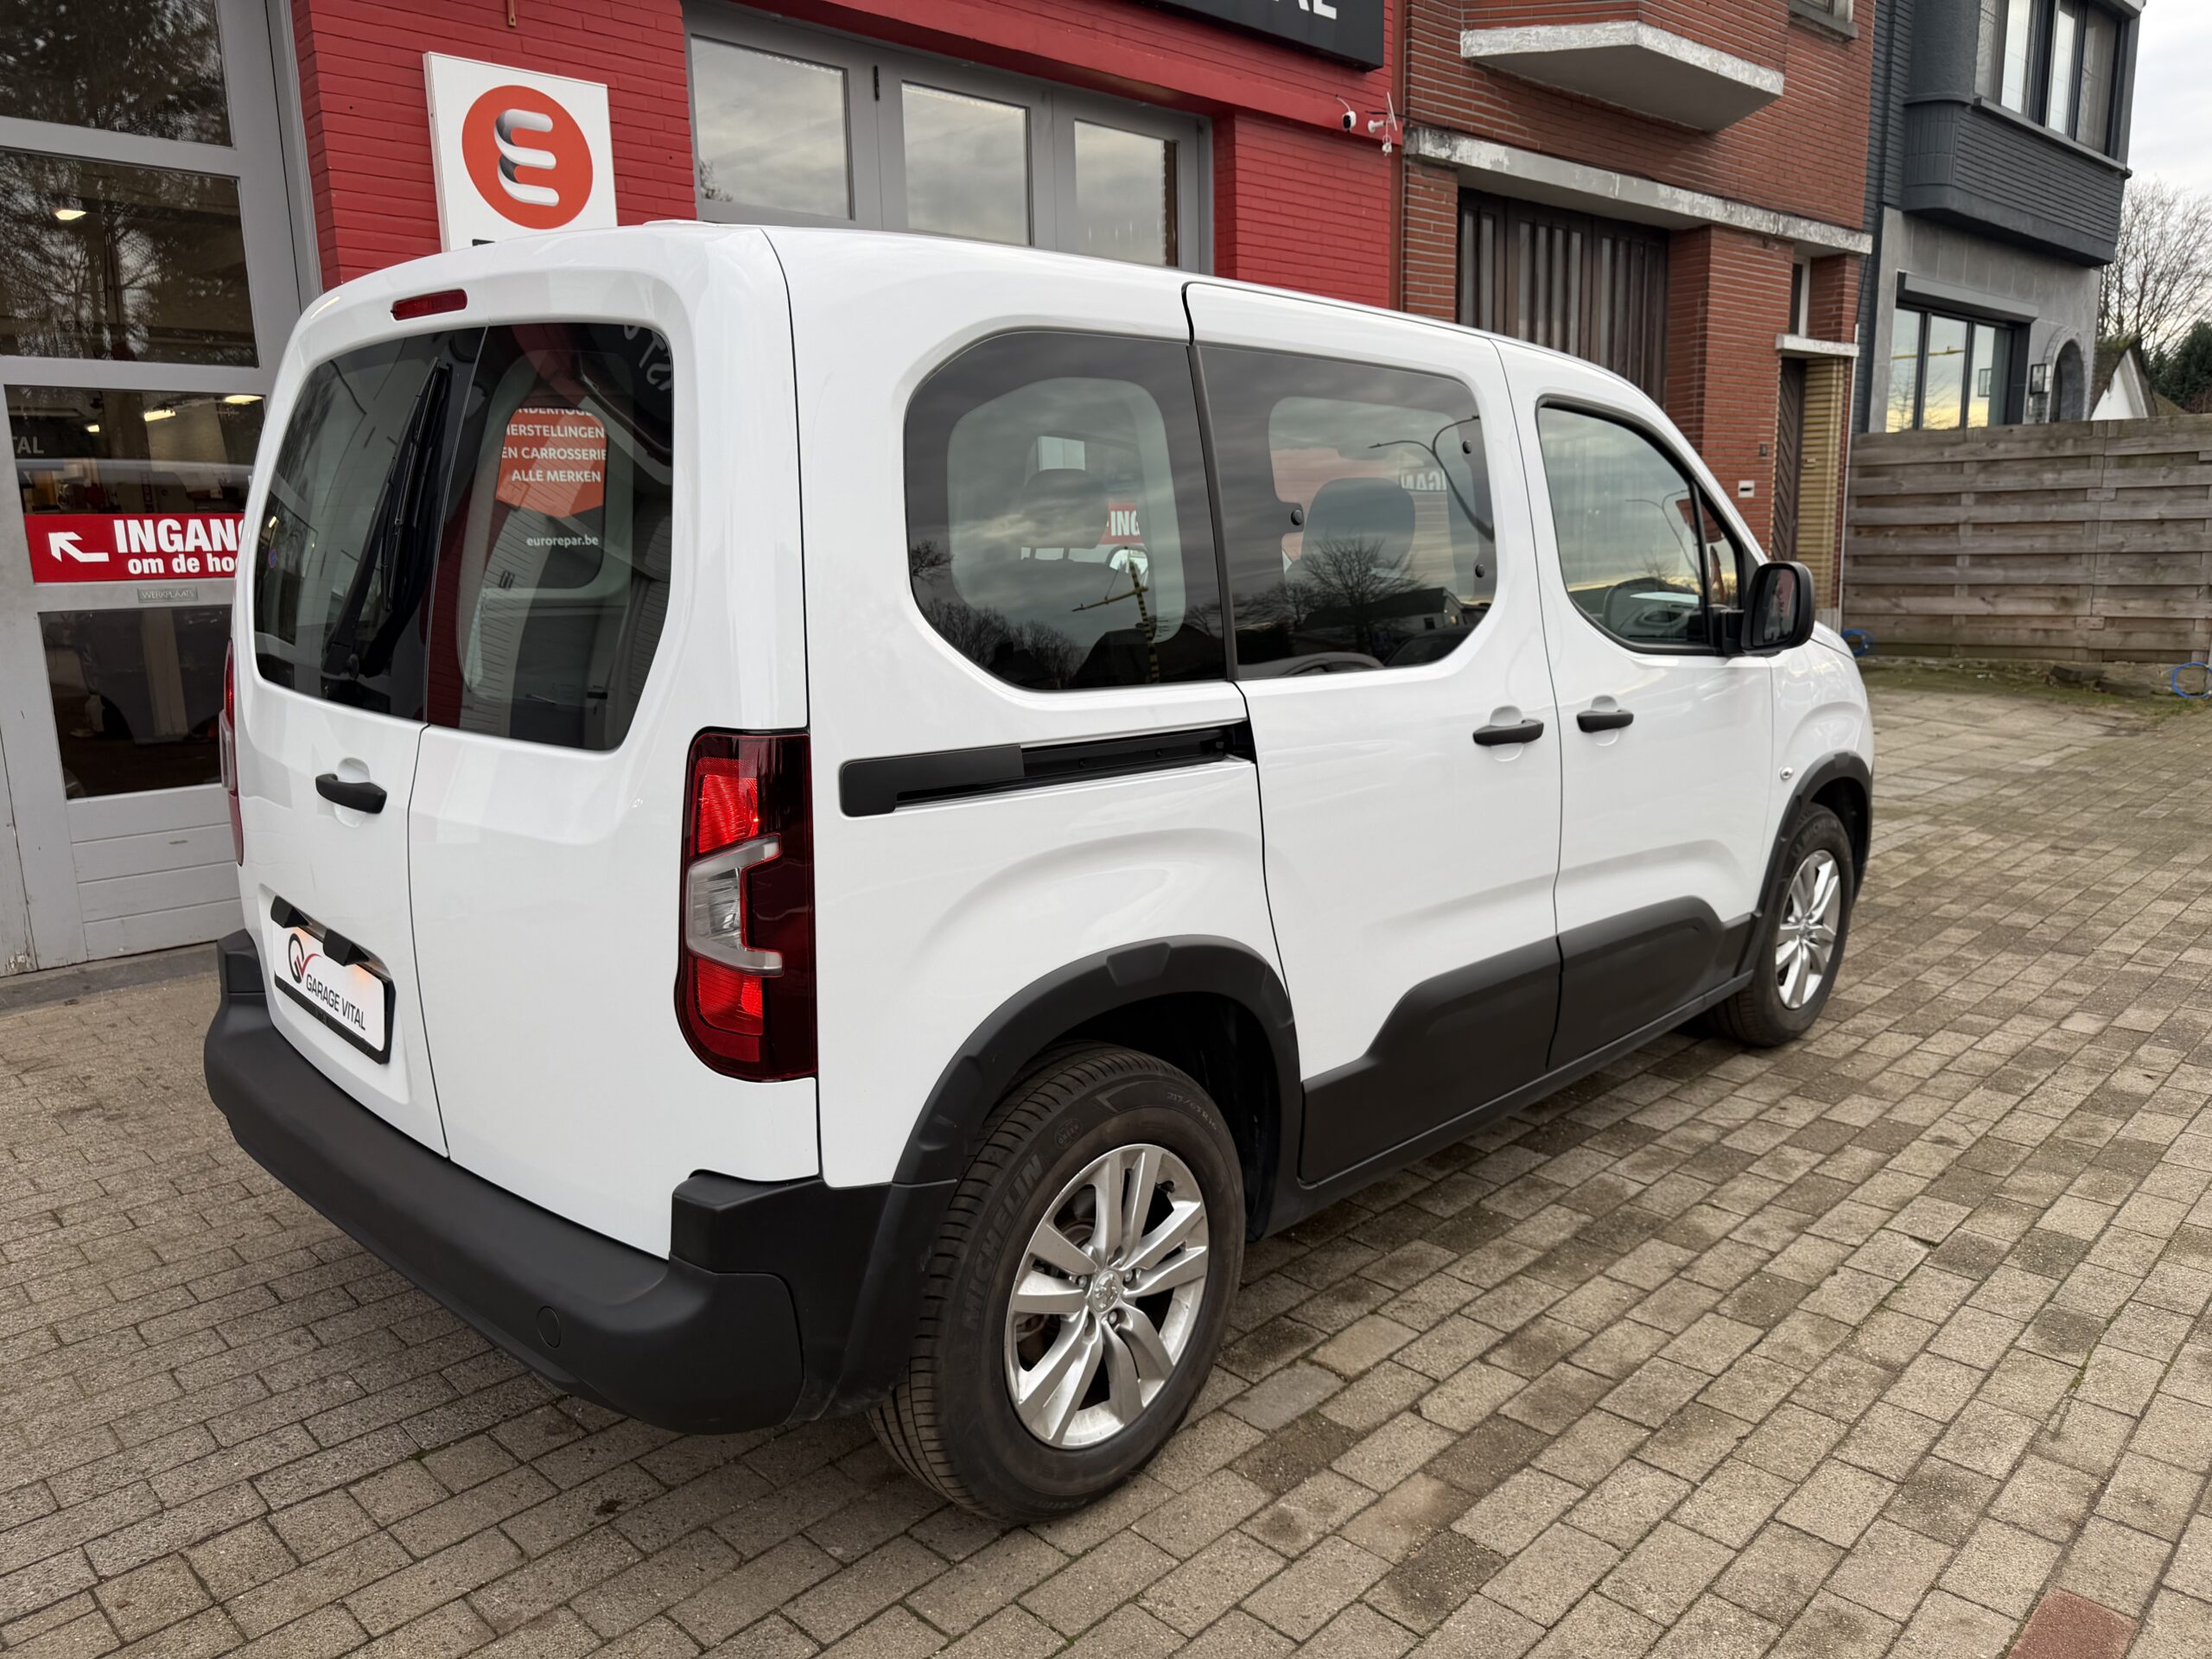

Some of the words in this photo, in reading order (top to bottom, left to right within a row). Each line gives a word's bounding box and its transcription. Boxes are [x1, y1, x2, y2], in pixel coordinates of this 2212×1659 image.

[12, 435, 45, 454] AL
[512, 469, 543, 482] ALLE
[546, 470, 601, 483] MERKEN
[113, 518, 245, 554] INGAN
[525, 534, 600, 549] eurorepar.be
[128, 558, 165, 575] om
[172, 554, 200, 575] de
[207, 553, 238, 573] ho
[306, 973, 340, 1013] GARAGE
[341, 996, 366, 1031] VITAL
[961, 1153, 1044, 1332] MICHELIN
